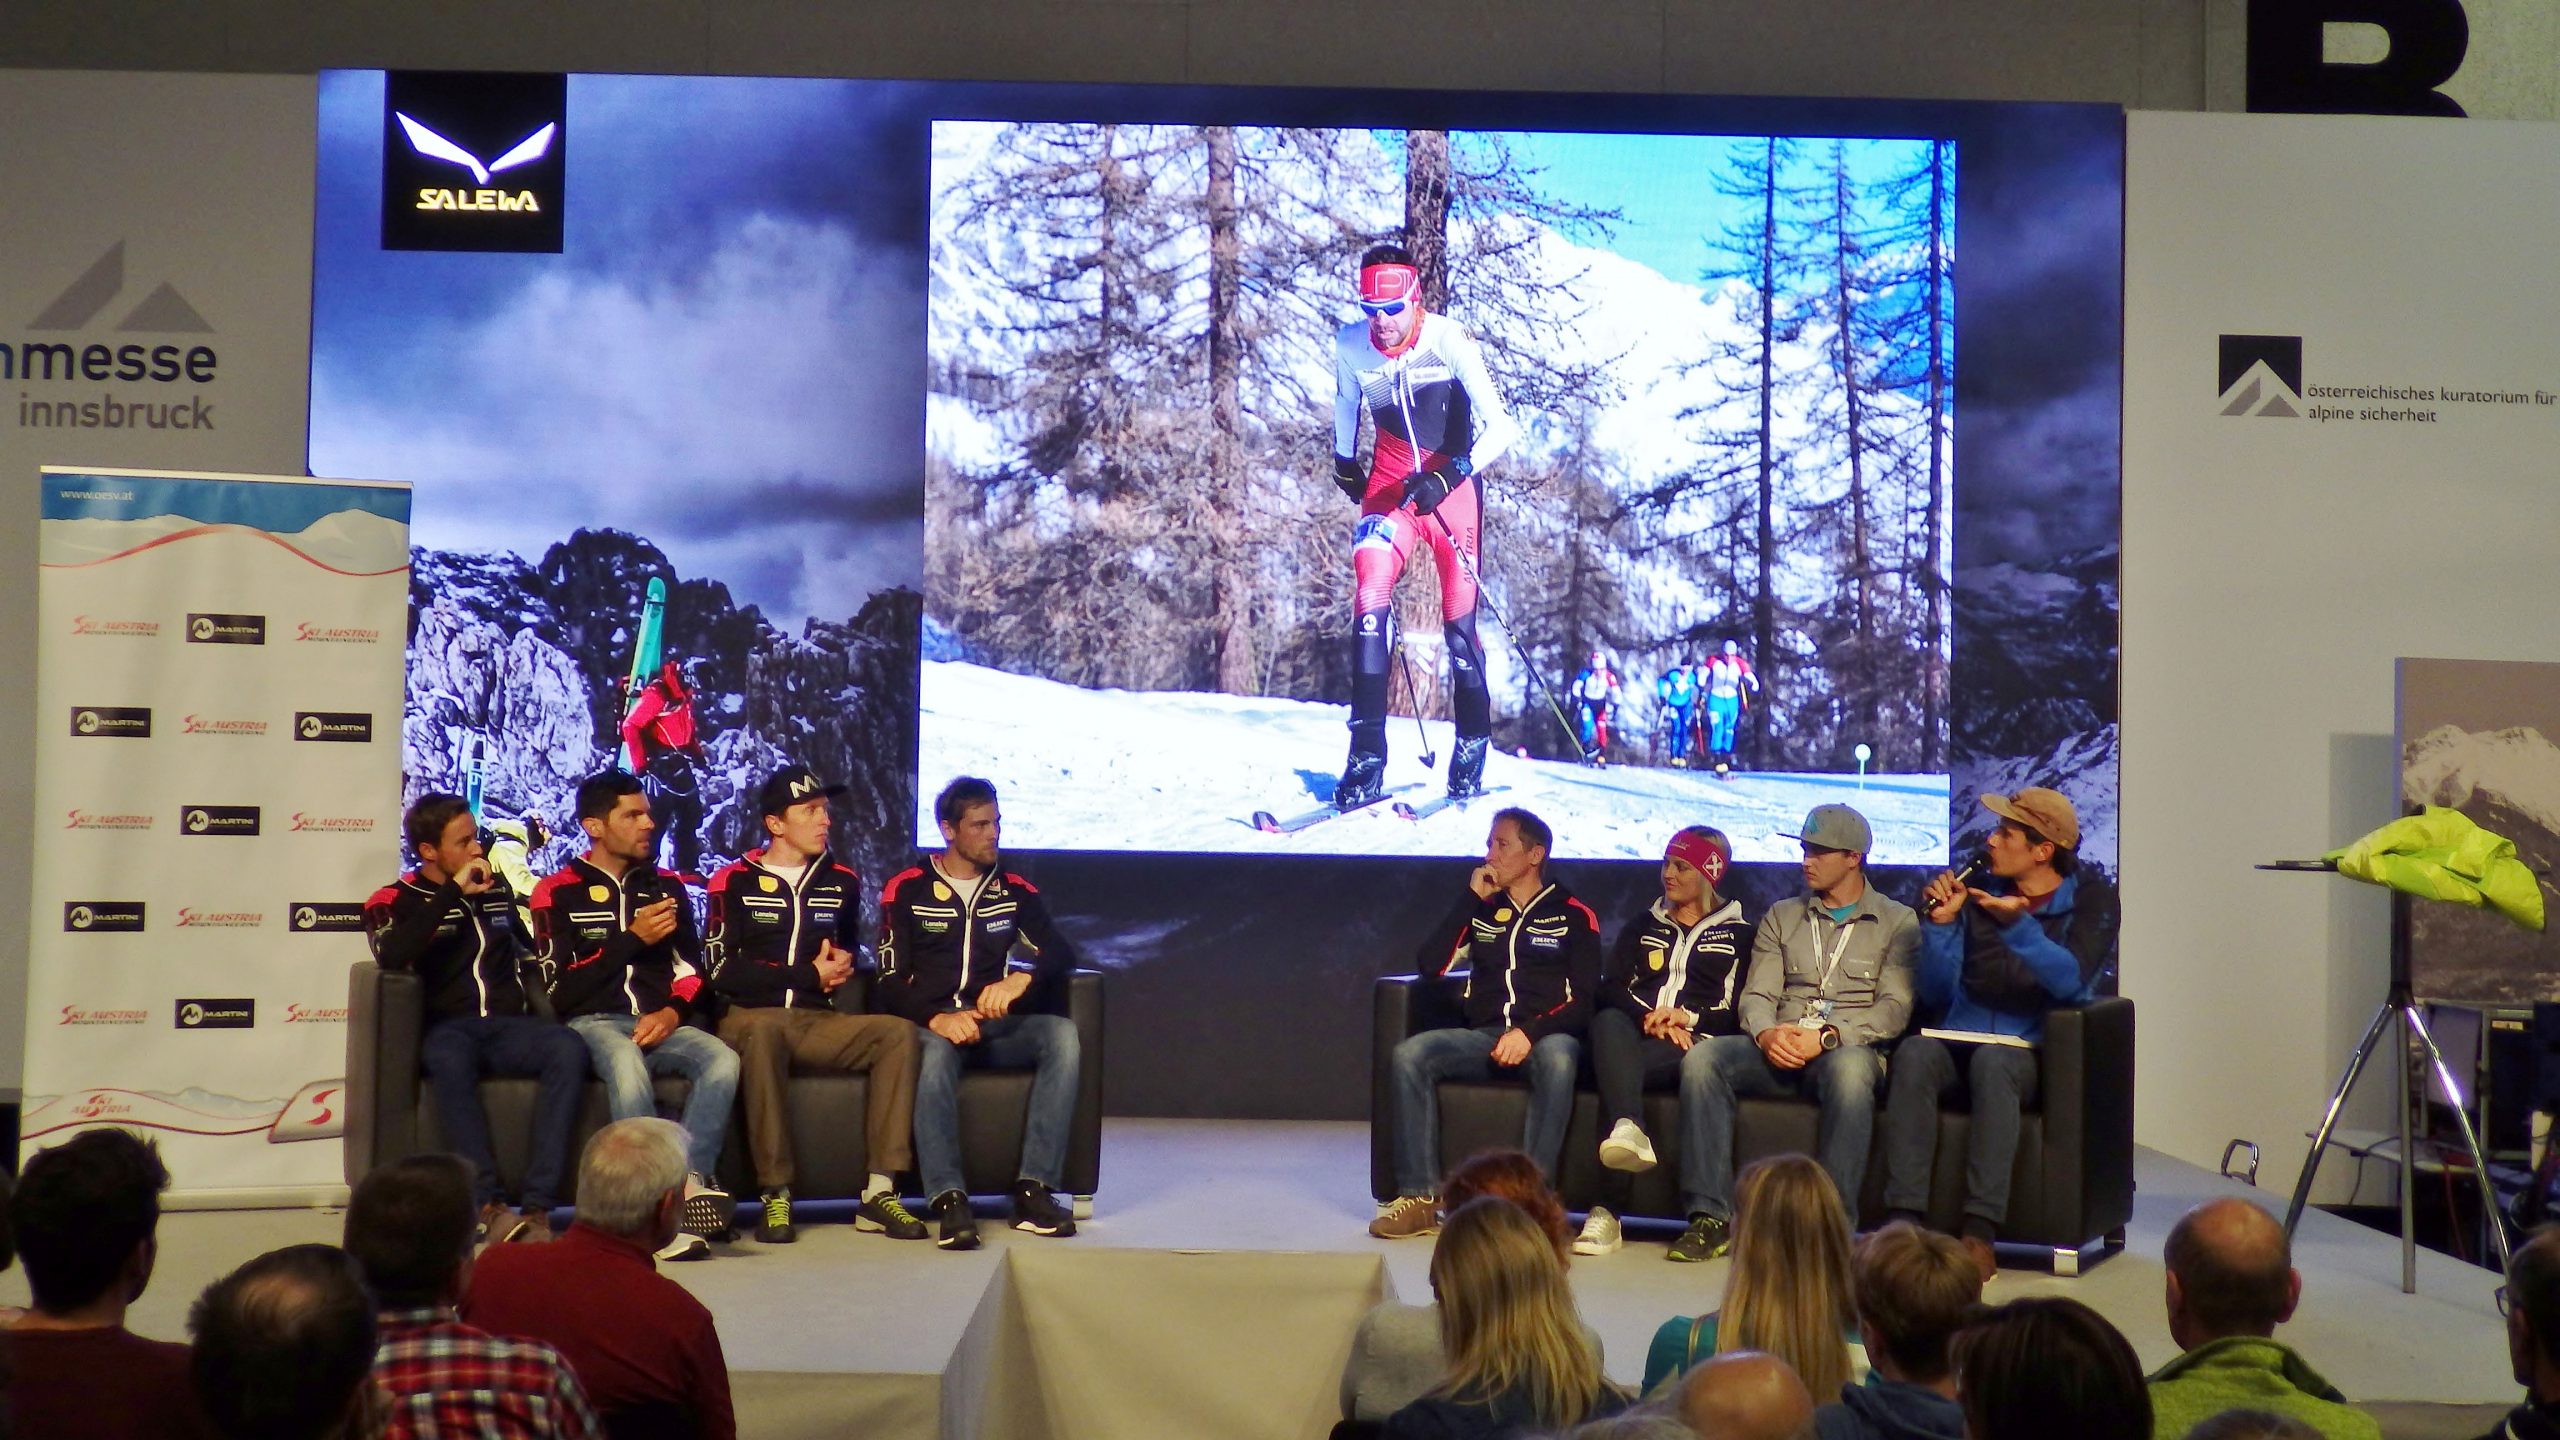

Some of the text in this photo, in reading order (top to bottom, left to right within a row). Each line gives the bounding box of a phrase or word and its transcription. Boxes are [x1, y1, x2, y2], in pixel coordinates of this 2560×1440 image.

[415, 188, 540, 211] SALEWA
[2307, 384, 2558, 406] österreichisches kuratorium für
[19, 392, 215, 430] innsbruck
[2308, 405, 2437, 423] alpine sicherheit
[215, 625, 259, 635] MARTINI
[322, 723, 366, 733] MARTINI
[209, 817, 254, 826] MARTINI
[317, 913, 361, 922] MARTINI
[204, 1009, 249, 1019] MARTINI
